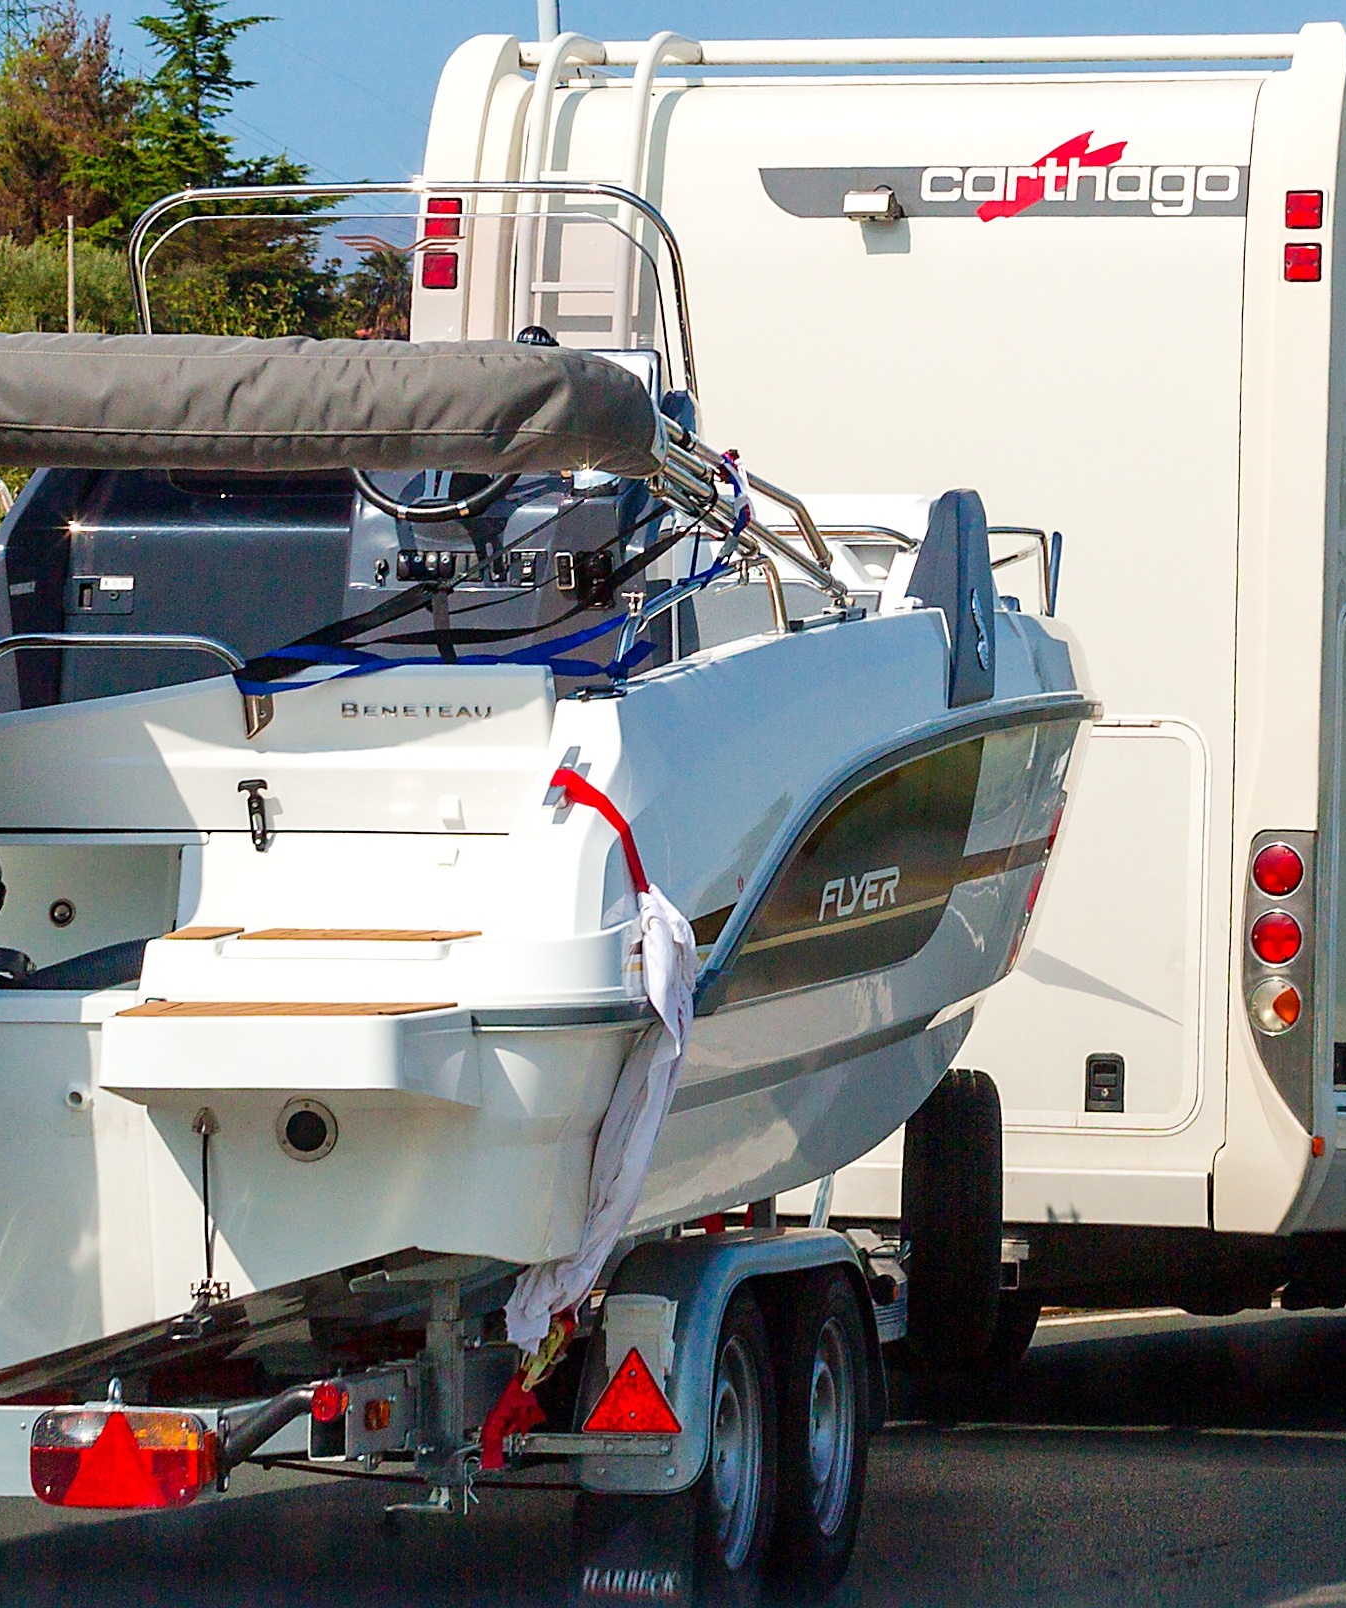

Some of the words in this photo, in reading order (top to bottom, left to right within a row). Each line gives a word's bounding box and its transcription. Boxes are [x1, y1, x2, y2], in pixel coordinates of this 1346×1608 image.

[920, 157, 1241, 216] carthago
[341, 702, 493, 719] BENETEAU
[818, 865, 900, 922] FLYER
